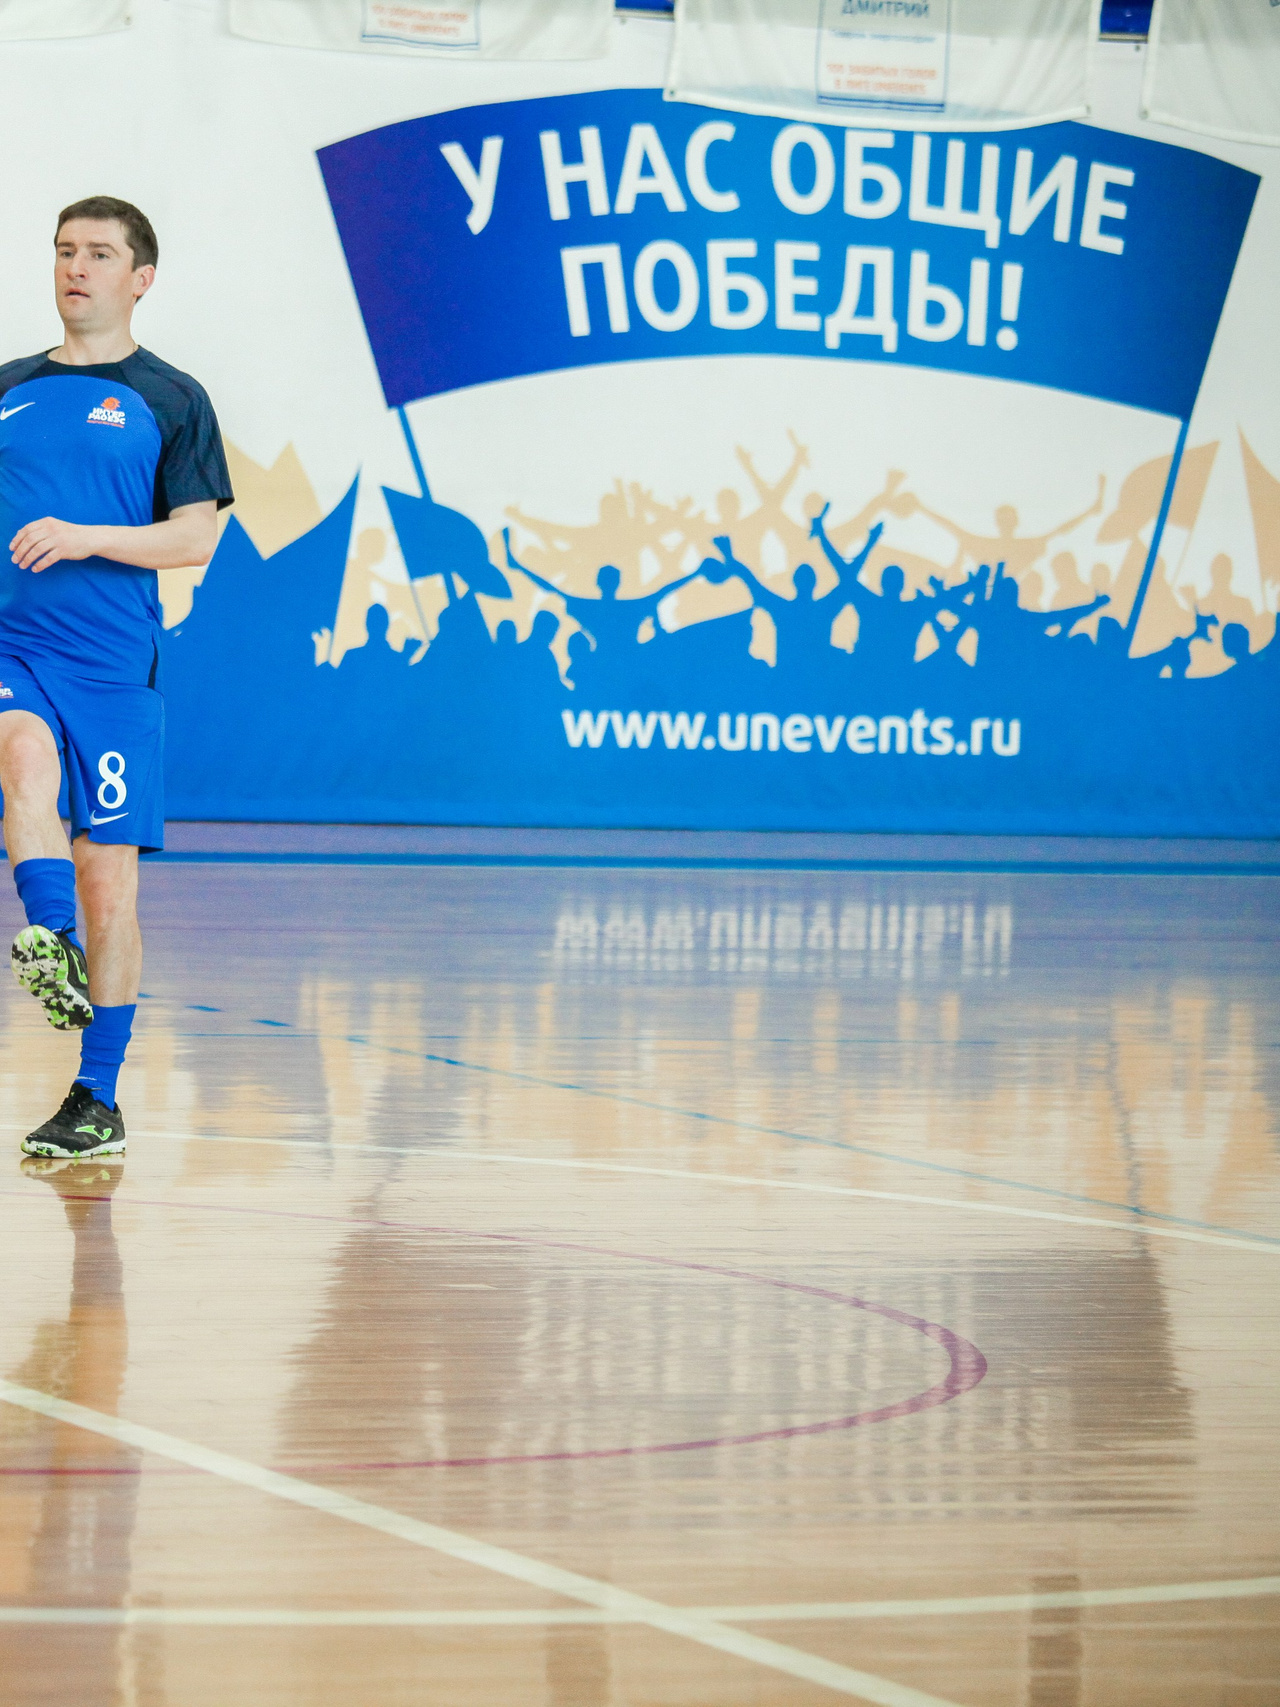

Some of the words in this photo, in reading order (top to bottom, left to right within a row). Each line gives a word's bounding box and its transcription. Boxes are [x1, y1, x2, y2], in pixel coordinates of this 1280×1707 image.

[440, 136, 504, 236] У
[538, 121, 741, 221] НАС
[769, 123, 1136, 256] ОБЩИЕ
[560, 239, 1024, 353] ПОБЕДЫ!
[561, 708, 1021, 757] www.unevents.ru
[97, 751, 127, 809] 8
